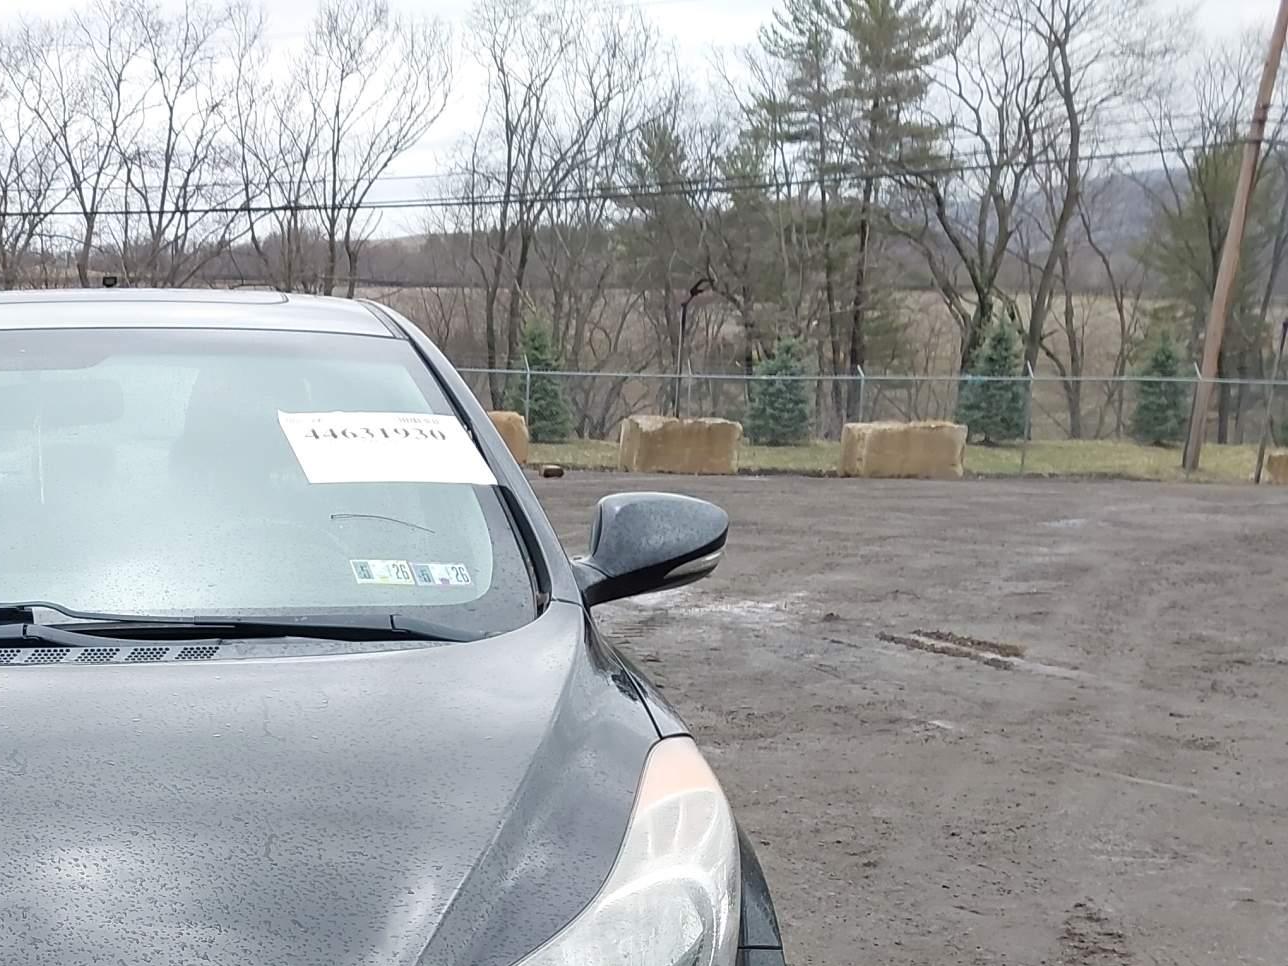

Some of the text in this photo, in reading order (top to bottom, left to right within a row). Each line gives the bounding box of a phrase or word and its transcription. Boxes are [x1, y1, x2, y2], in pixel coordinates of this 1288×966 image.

[304, 427, 447, 441] 44631930
[392, 563, 410, 580] 26
[452, 566, 470, 583] 26
